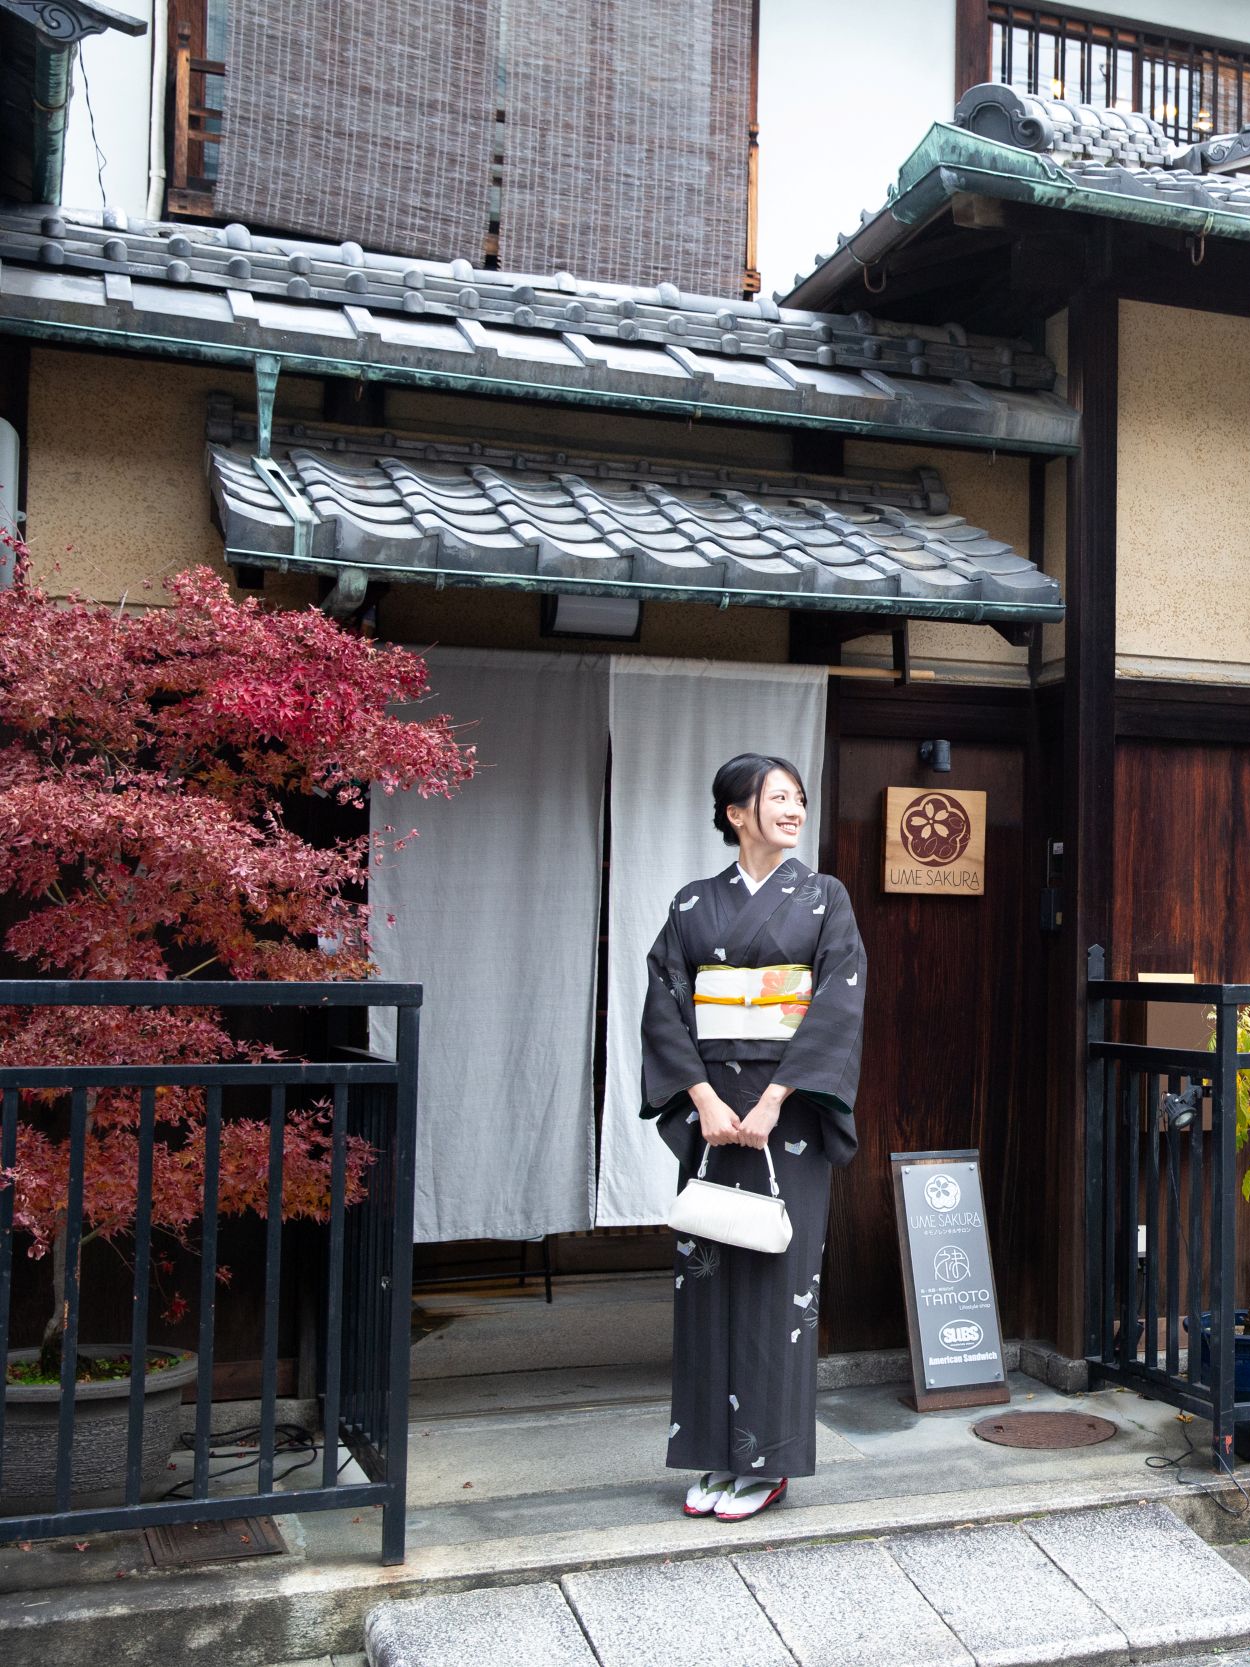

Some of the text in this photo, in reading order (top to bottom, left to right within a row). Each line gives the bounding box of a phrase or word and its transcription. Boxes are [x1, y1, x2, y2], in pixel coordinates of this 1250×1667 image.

[890, 868, 980, 891] UME SAKURA
[910, 1211, 982, 1229] UME SAKURA
[921, 1289, 990, 1307] TAMOTO
[943, 1325, 980, 1344] SUBS
[928, 1351, 998, 1366] American Sandwich
